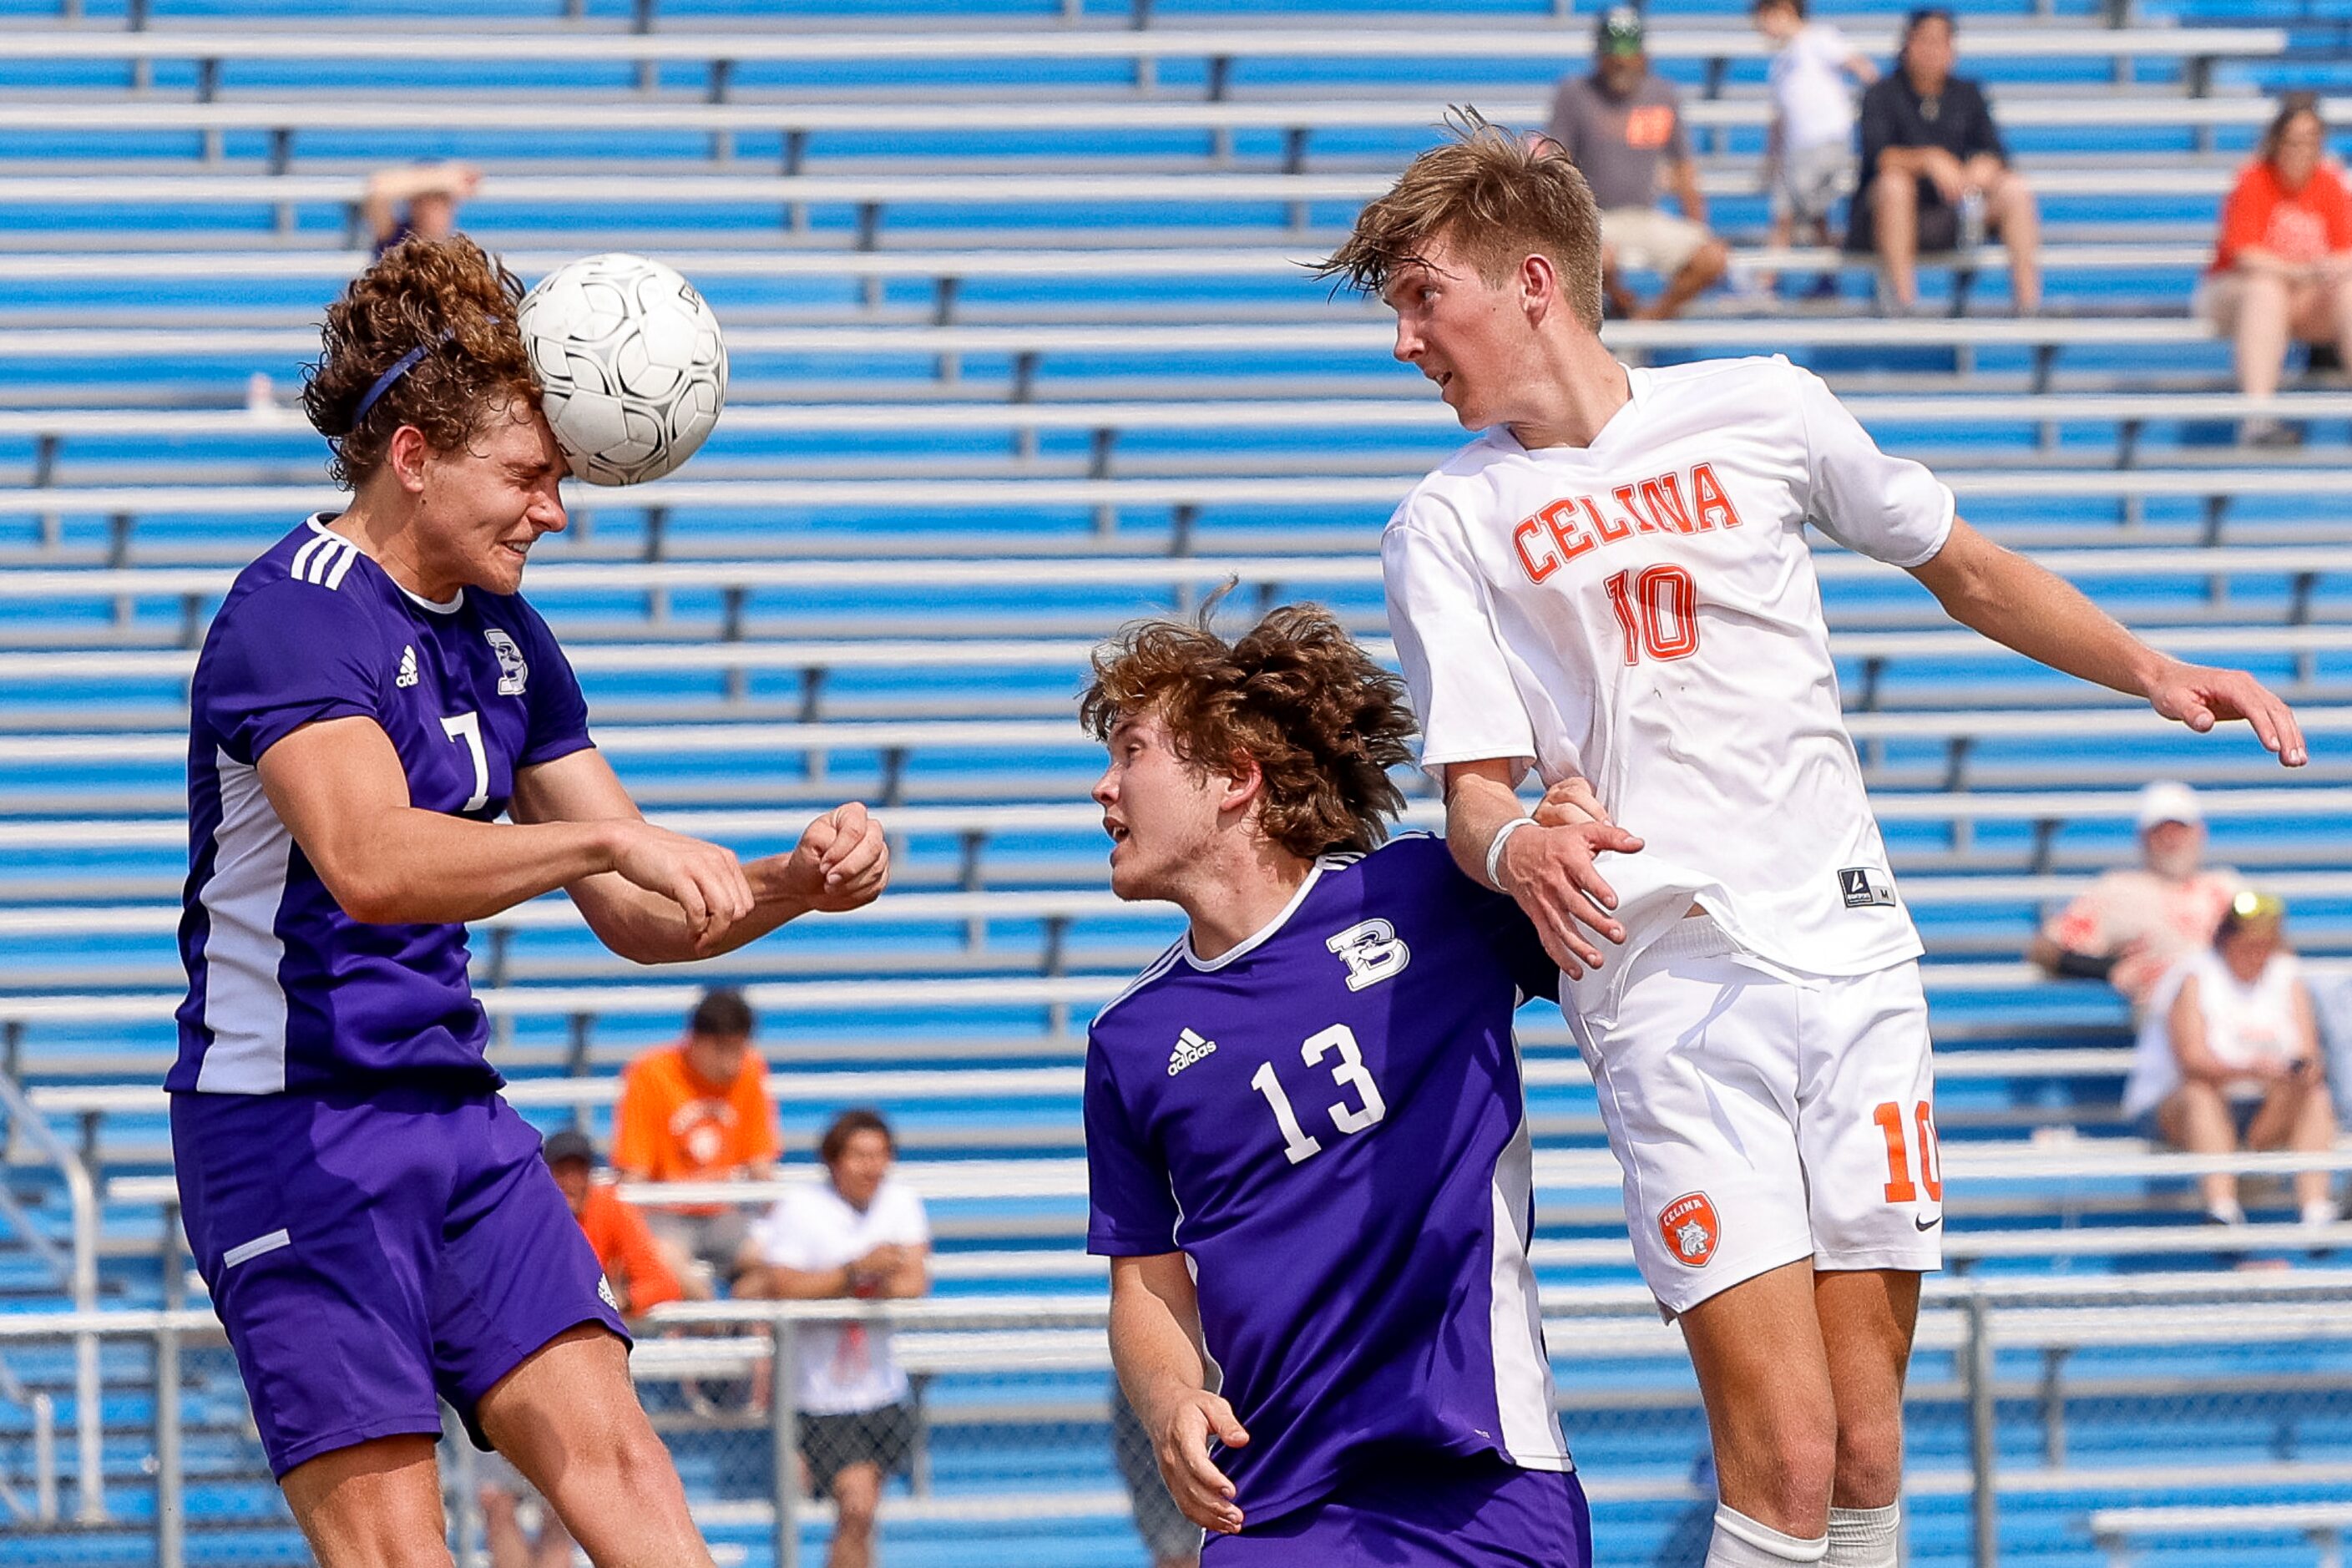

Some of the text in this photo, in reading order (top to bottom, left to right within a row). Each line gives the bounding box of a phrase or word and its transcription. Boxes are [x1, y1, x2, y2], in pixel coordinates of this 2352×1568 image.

[1513, 462, 1743, 584] CELINA
[1603, 563, 1700, 666] 10
[439, 711, 489, 812] 7
[1326, 918, 1410, 992] B
[1167, 1040, 1216, 1076] adidas
[1251, 1023, 1386, 1165] 13
[1663, 1199, 1703, 1227] CELINA
